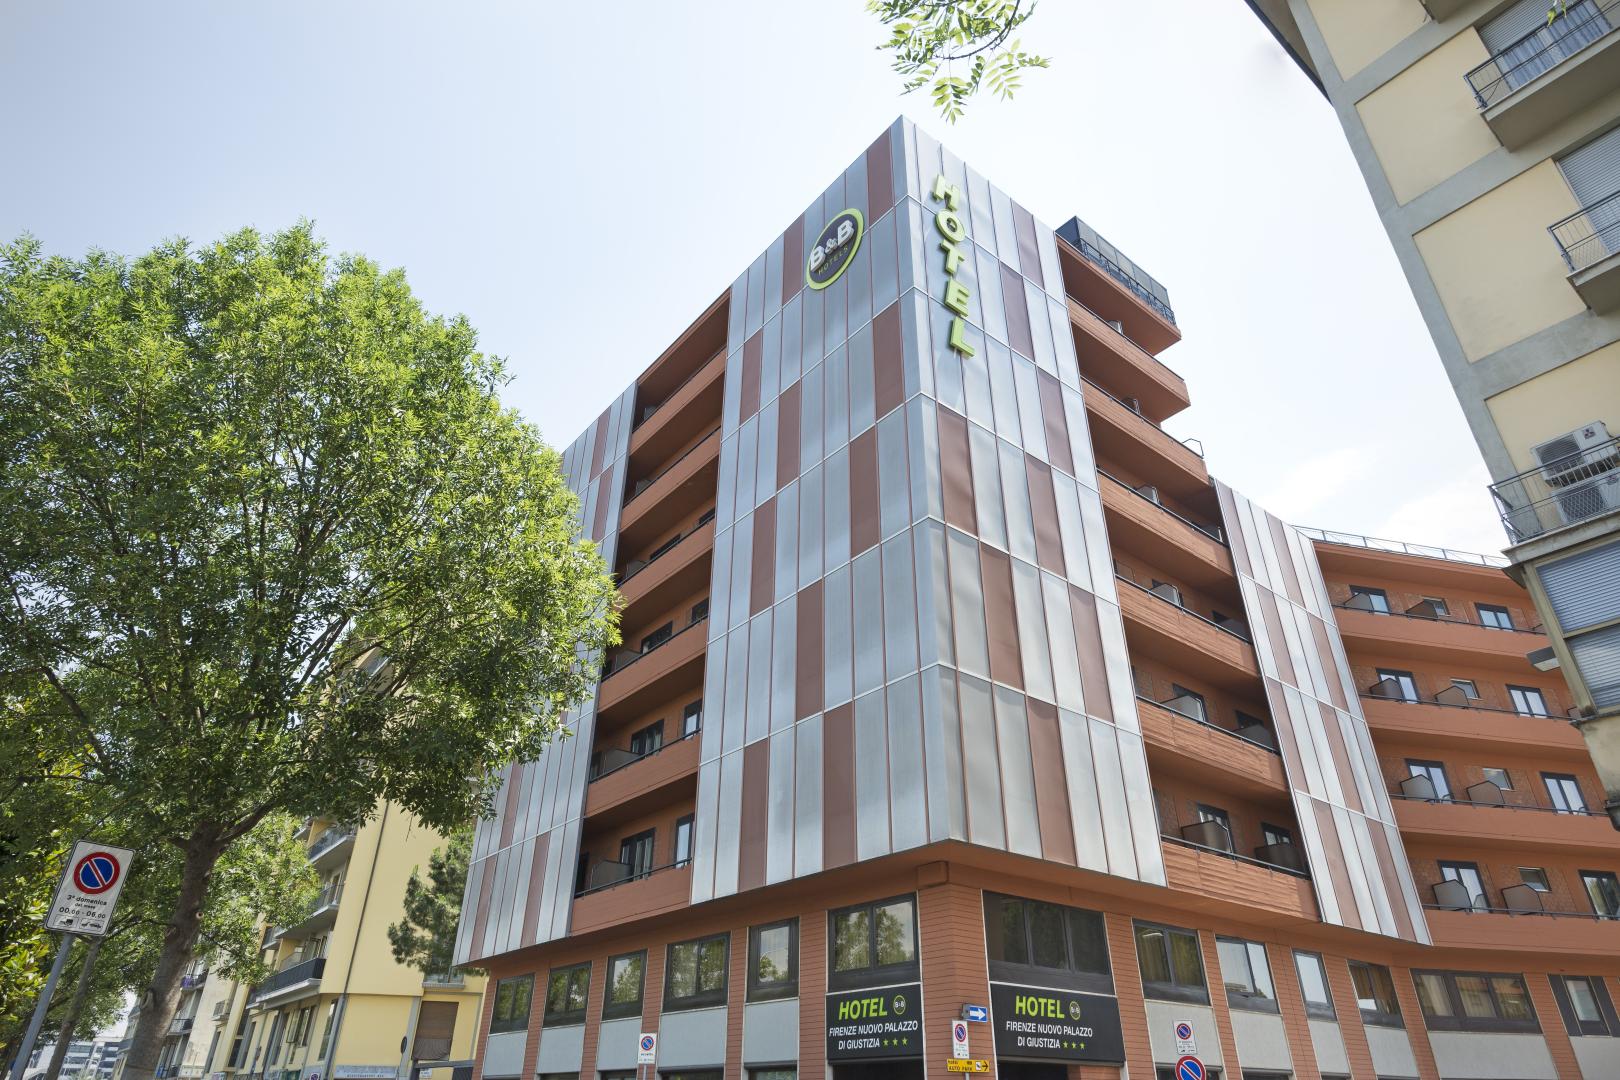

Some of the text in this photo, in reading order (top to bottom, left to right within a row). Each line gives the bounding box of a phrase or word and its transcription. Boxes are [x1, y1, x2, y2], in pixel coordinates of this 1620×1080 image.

[810, 219, 855, 272] B&B
[931, 174, 975, 359] HOTEL
[75, 896, 107, 906] domenica
[86, 910, 106, 919] 06.00
[838, 997, 888, 1020] HOTEL
[1015, 995, 1065, 1019] HOTEL
[829, 1020, 918, 1037] FIRENZE NUOVO PALAZZO
[1006, 1021, 1093, 1038] FIRENZE NUOVO PALAZZO
[838, 1038, 880, 1050] DI GIUSTIZIA
[1017, 1036, 1060, 1049] DI GIUSTIZIA
